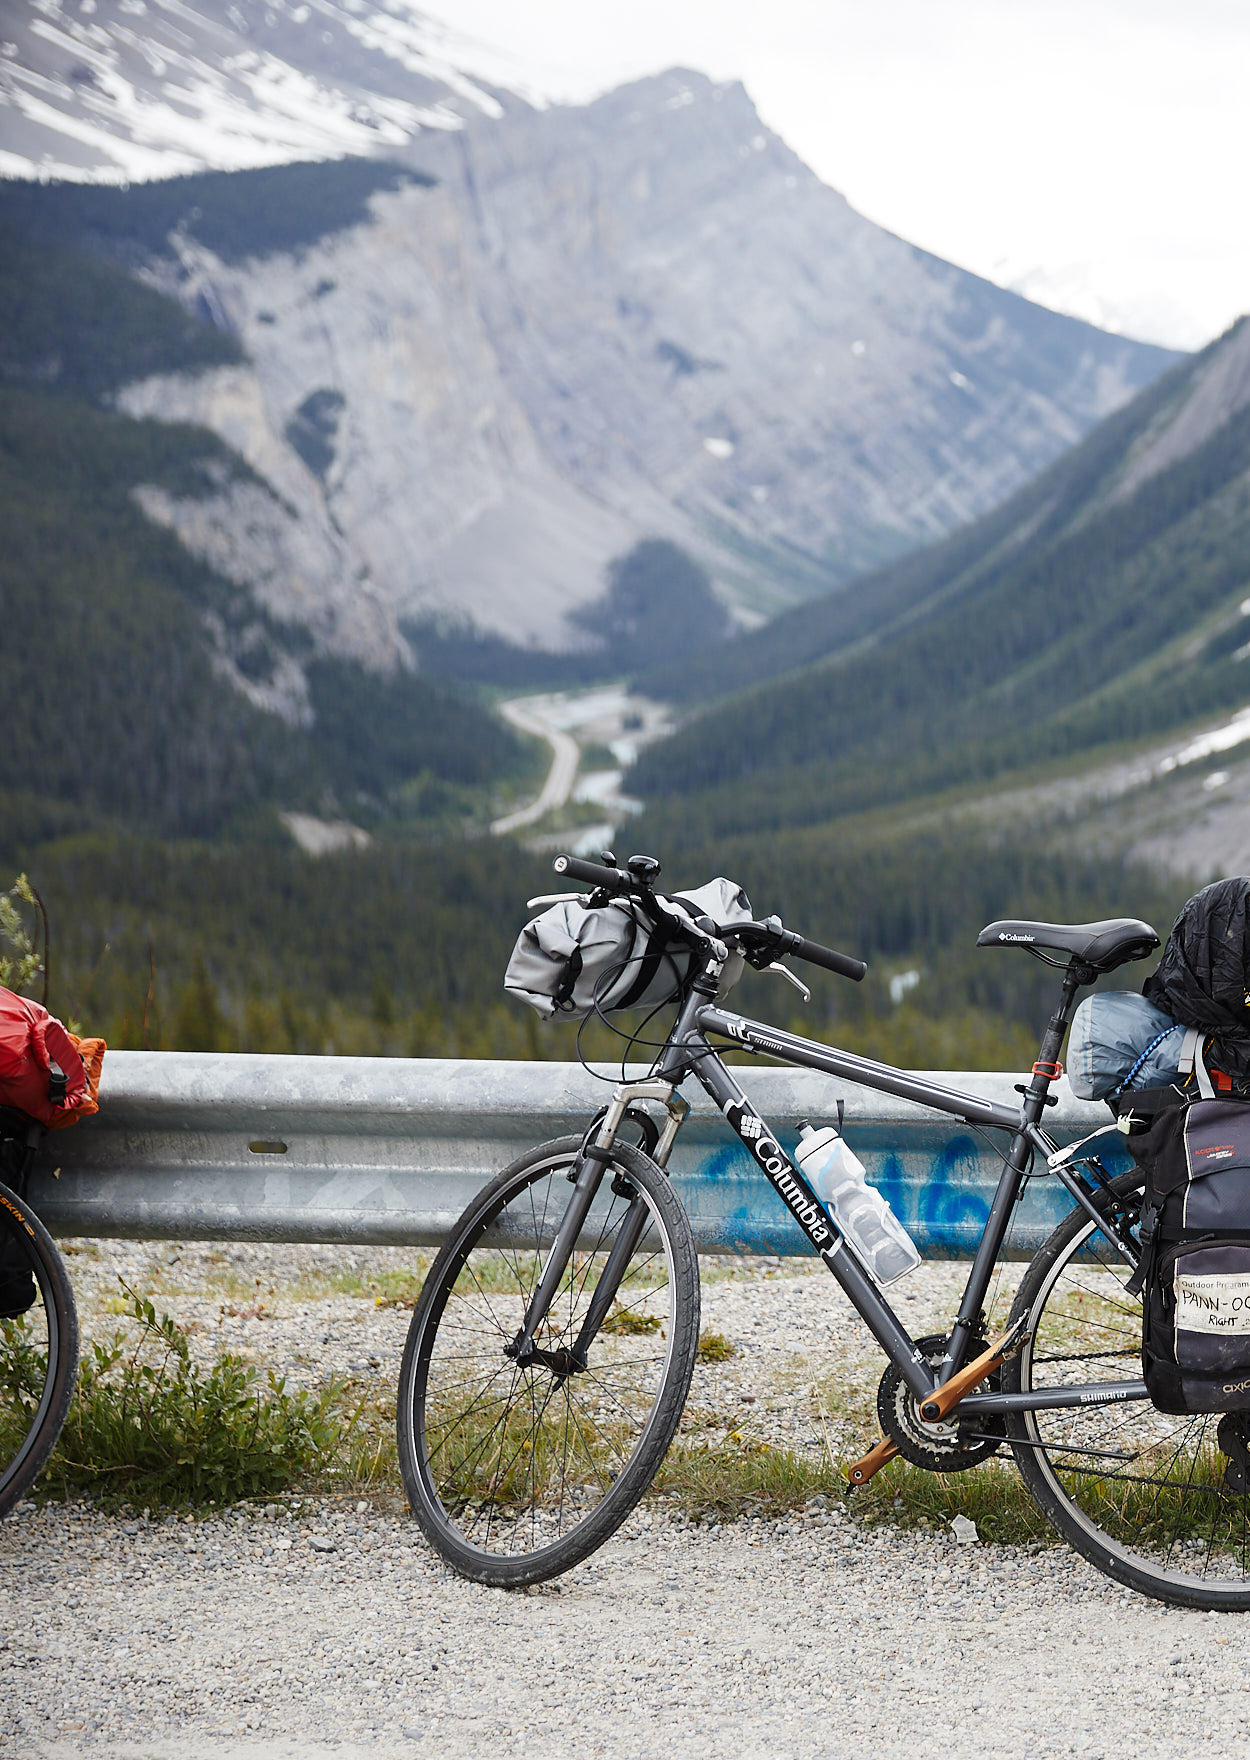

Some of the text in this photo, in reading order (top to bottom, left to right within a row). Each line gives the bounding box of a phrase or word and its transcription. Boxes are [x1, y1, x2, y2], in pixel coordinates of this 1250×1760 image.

[1005, 933, 1036, 942] Columbia
[755, 1137, 829, 1243] Columbia
[0, 1194, 25, 1222] SKIN
[1181, 1280, 1214, 1289] Outdoor
[1208, 1314, 1239, 1327] RIGHT
[1081, 1390, 1127, 1403] SHIMANO
